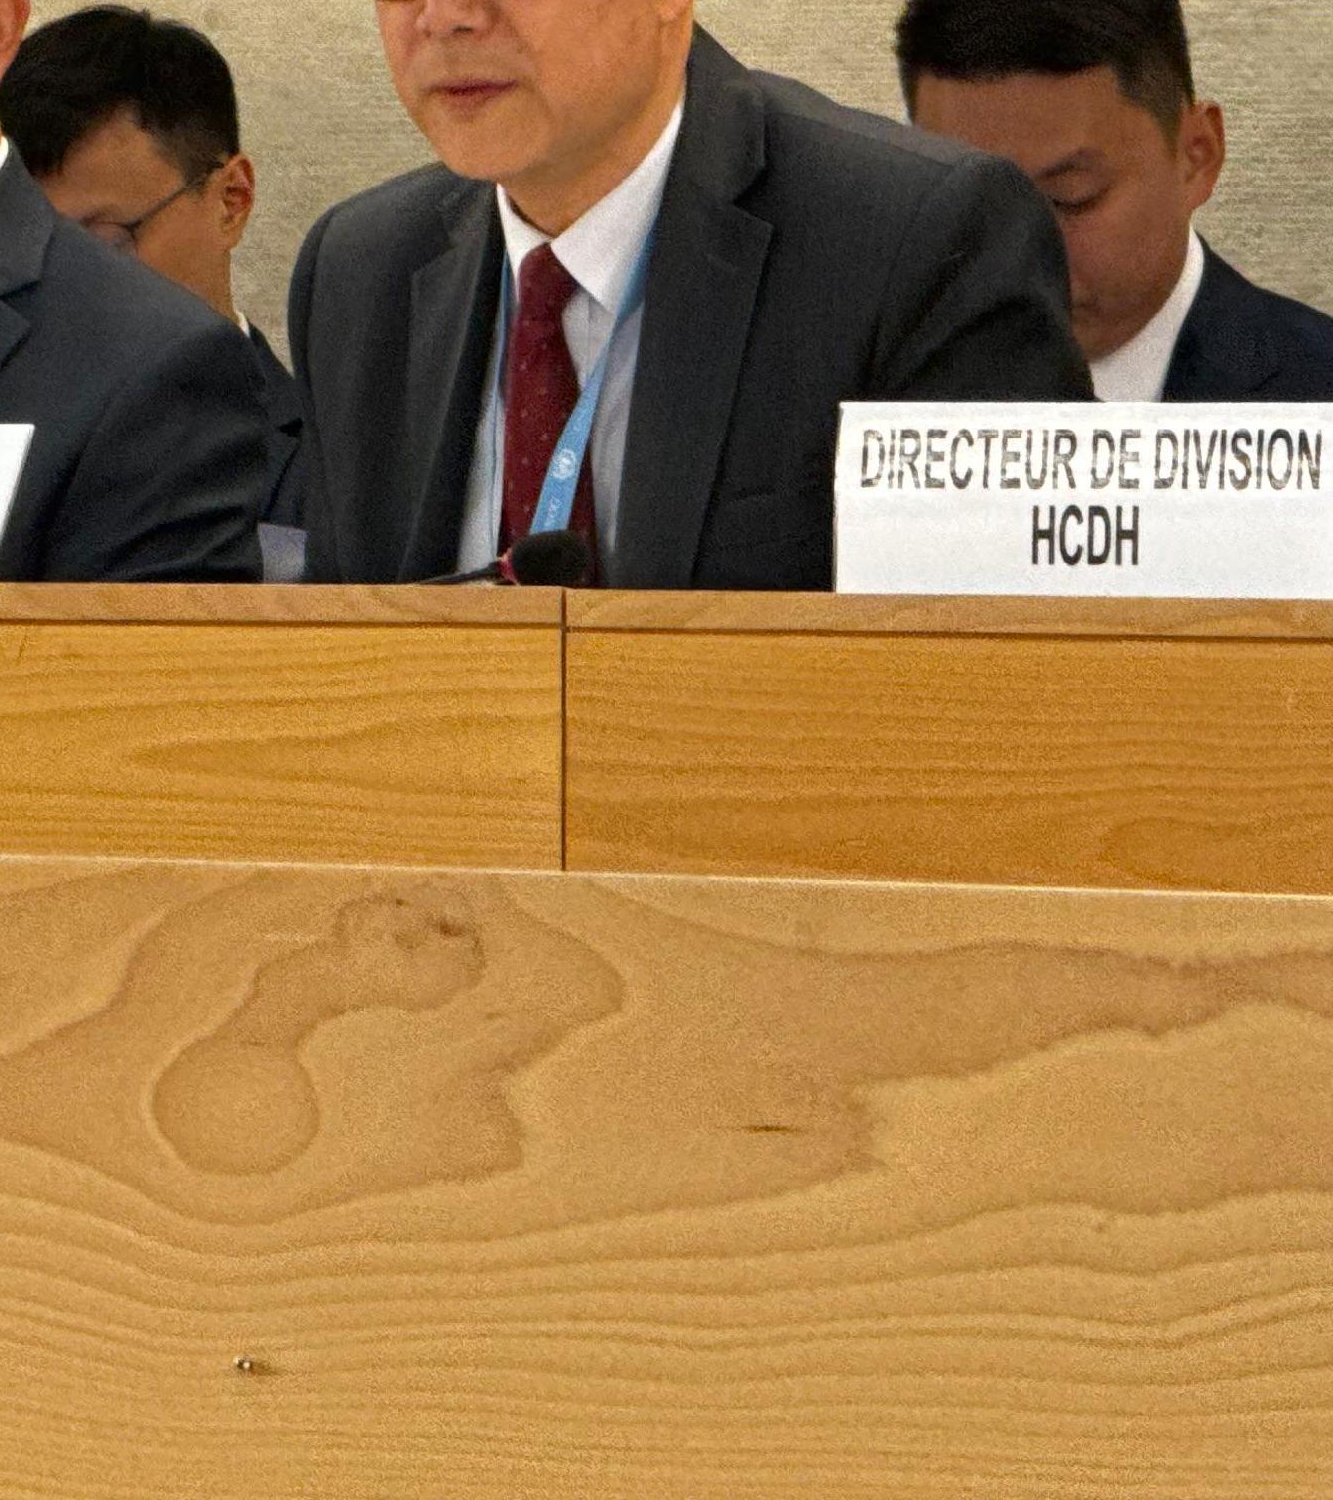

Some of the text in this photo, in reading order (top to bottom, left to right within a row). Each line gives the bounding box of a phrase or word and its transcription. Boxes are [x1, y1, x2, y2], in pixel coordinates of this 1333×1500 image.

[861, 429, 1322, 490] DIRECTEUR DE DIVISION
[1032, 505, 1140, 566] HCDH
